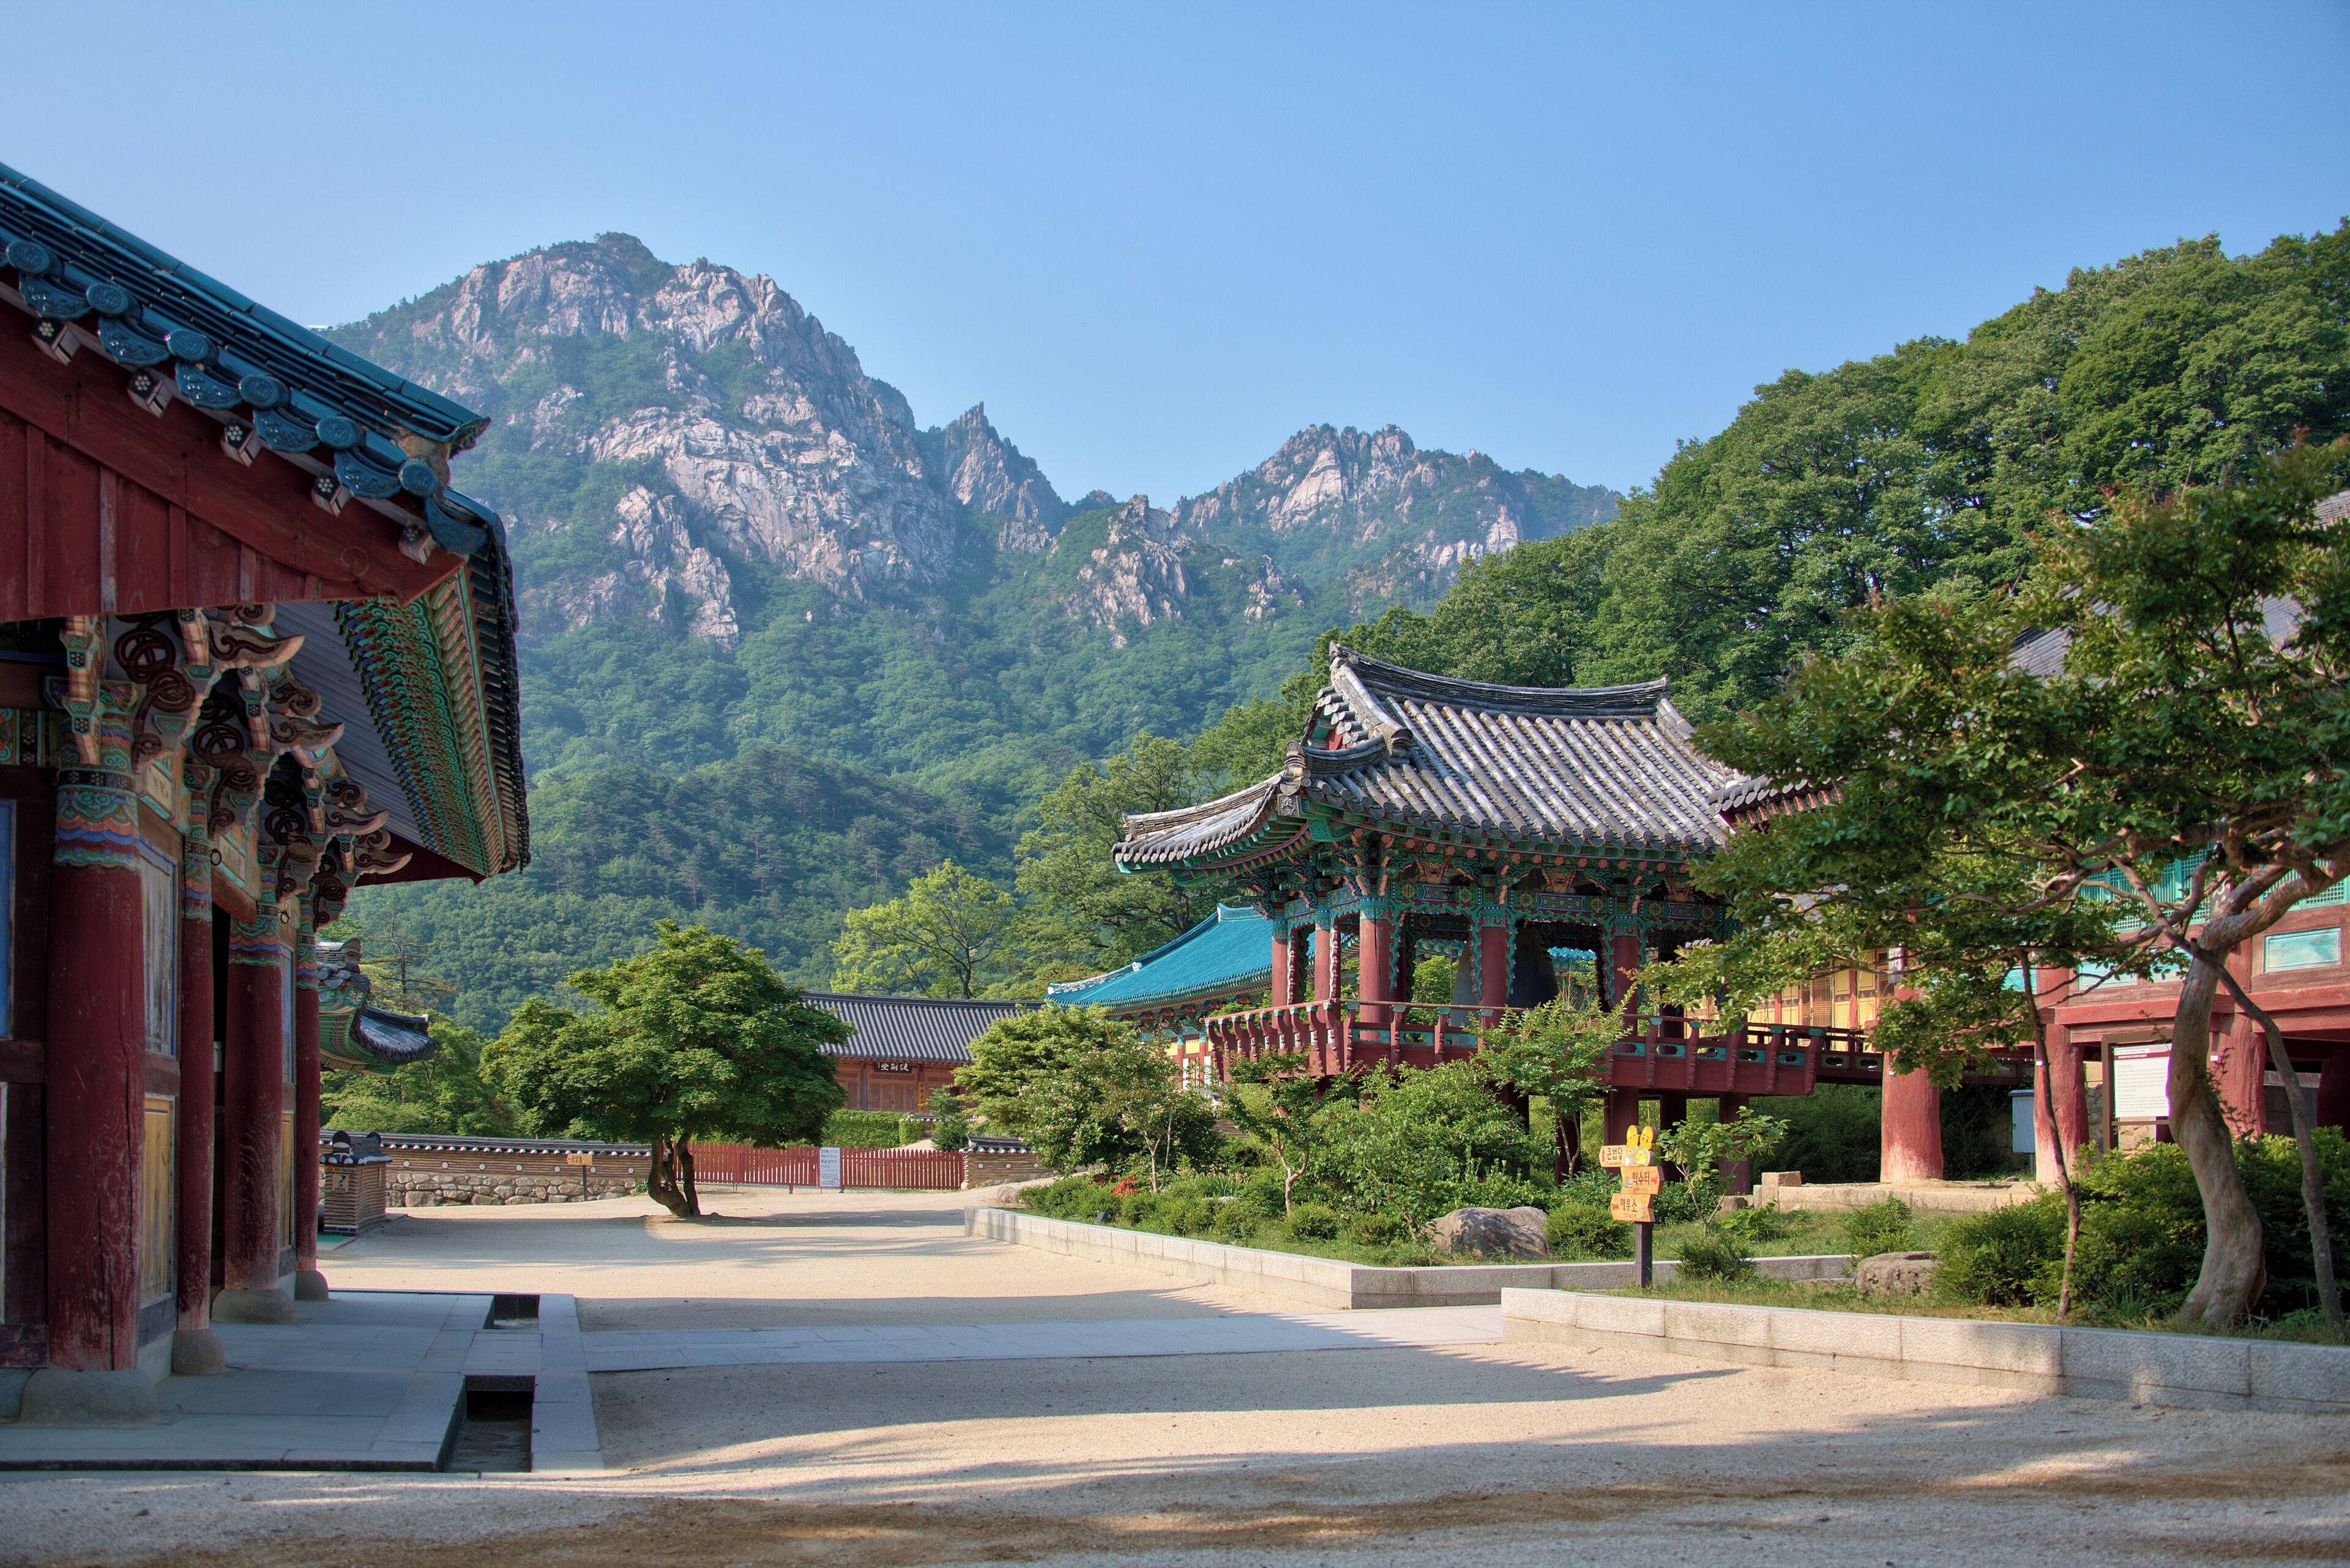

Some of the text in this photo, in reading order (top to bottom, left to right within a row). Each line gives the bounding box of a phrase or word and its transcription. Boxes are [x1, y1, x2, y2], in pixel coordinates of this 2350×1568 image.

[1606, 1148, 1622, 1160] 큰법당
[1632, 1171, 1650, 1185] 약수터
[1620, 1197, 1638, 1212] 해우소
